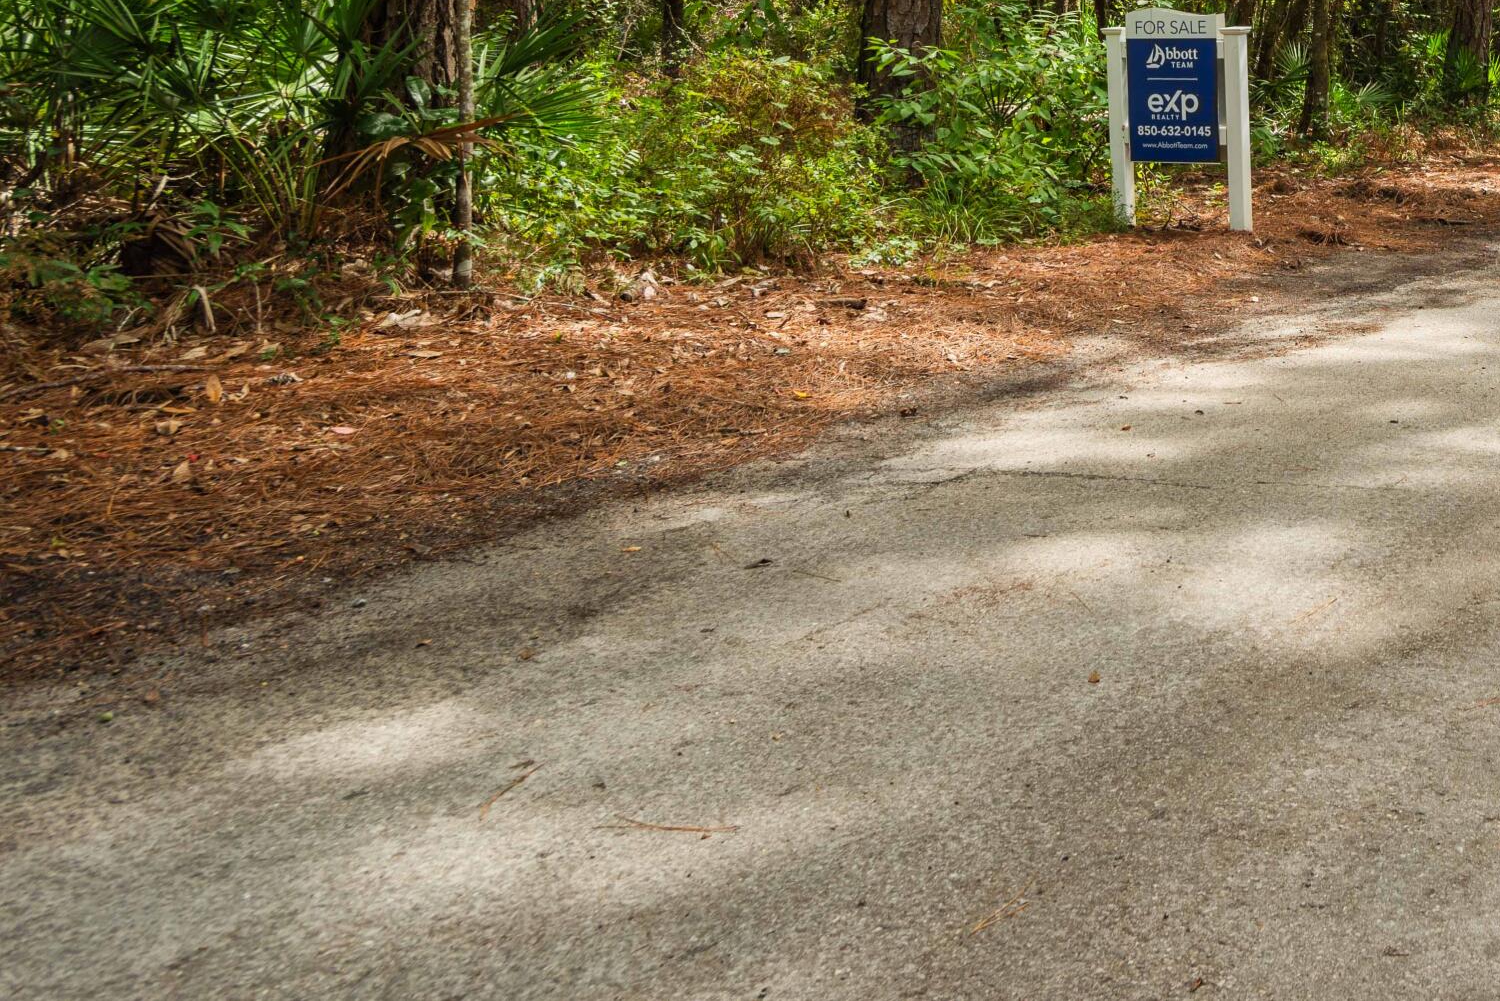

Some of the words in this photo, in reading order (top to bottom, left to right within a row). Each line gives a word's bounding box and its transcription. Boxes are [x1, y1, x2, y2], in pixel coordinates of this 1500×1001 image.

[1135, 20, 1165, 35] FOR
[1170, 20, 1207, 35] SALE
[1153, 43, 1198, 66] Abbott
[1171, 61, 1194, 69] TEAM
[1137, 125, 1212, 137] 850-632-0145
[1142, 141, 1208, 150] www.AbbottTeam.com
